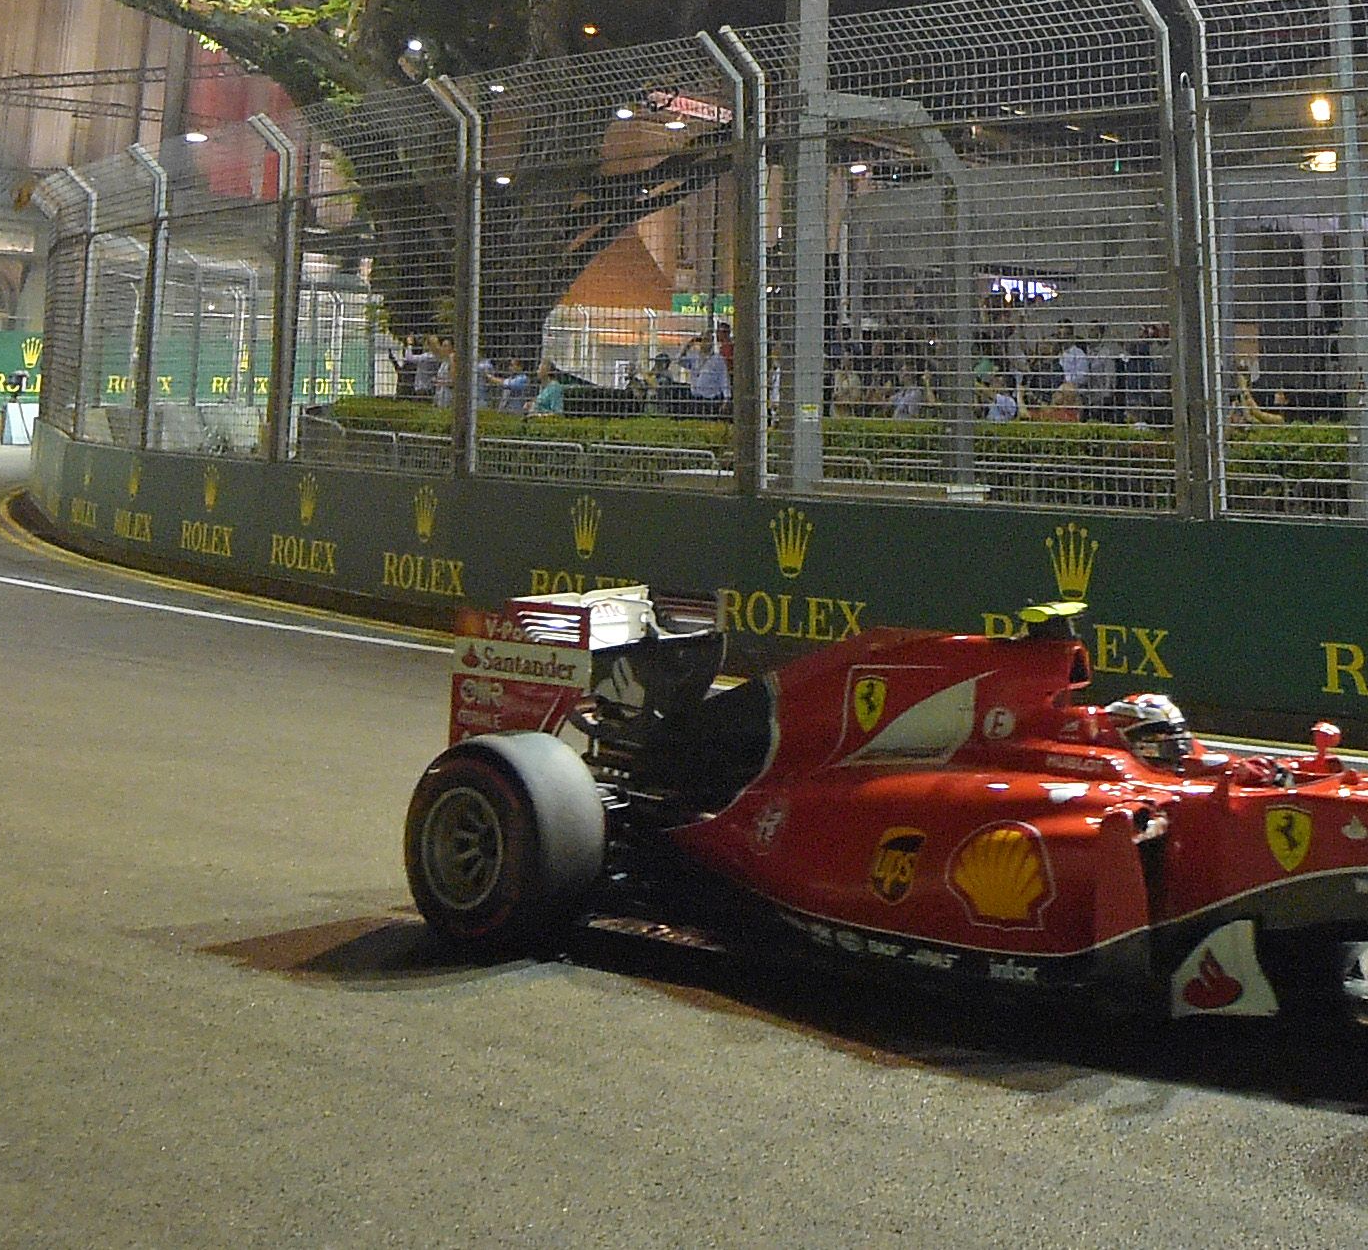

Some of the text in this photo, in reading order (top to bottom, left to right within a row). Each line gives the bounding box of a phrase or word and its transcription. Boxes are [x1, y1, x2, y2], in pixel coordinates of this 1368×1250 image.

[181, 520, 233, 558] ROLEX
[271, 534, 338, 575] ROLEX
[382, 552, 466, 597] ROLEX
[717, 587, 867, 642] ROLEX
[482, 646, 576, 681] Santander
